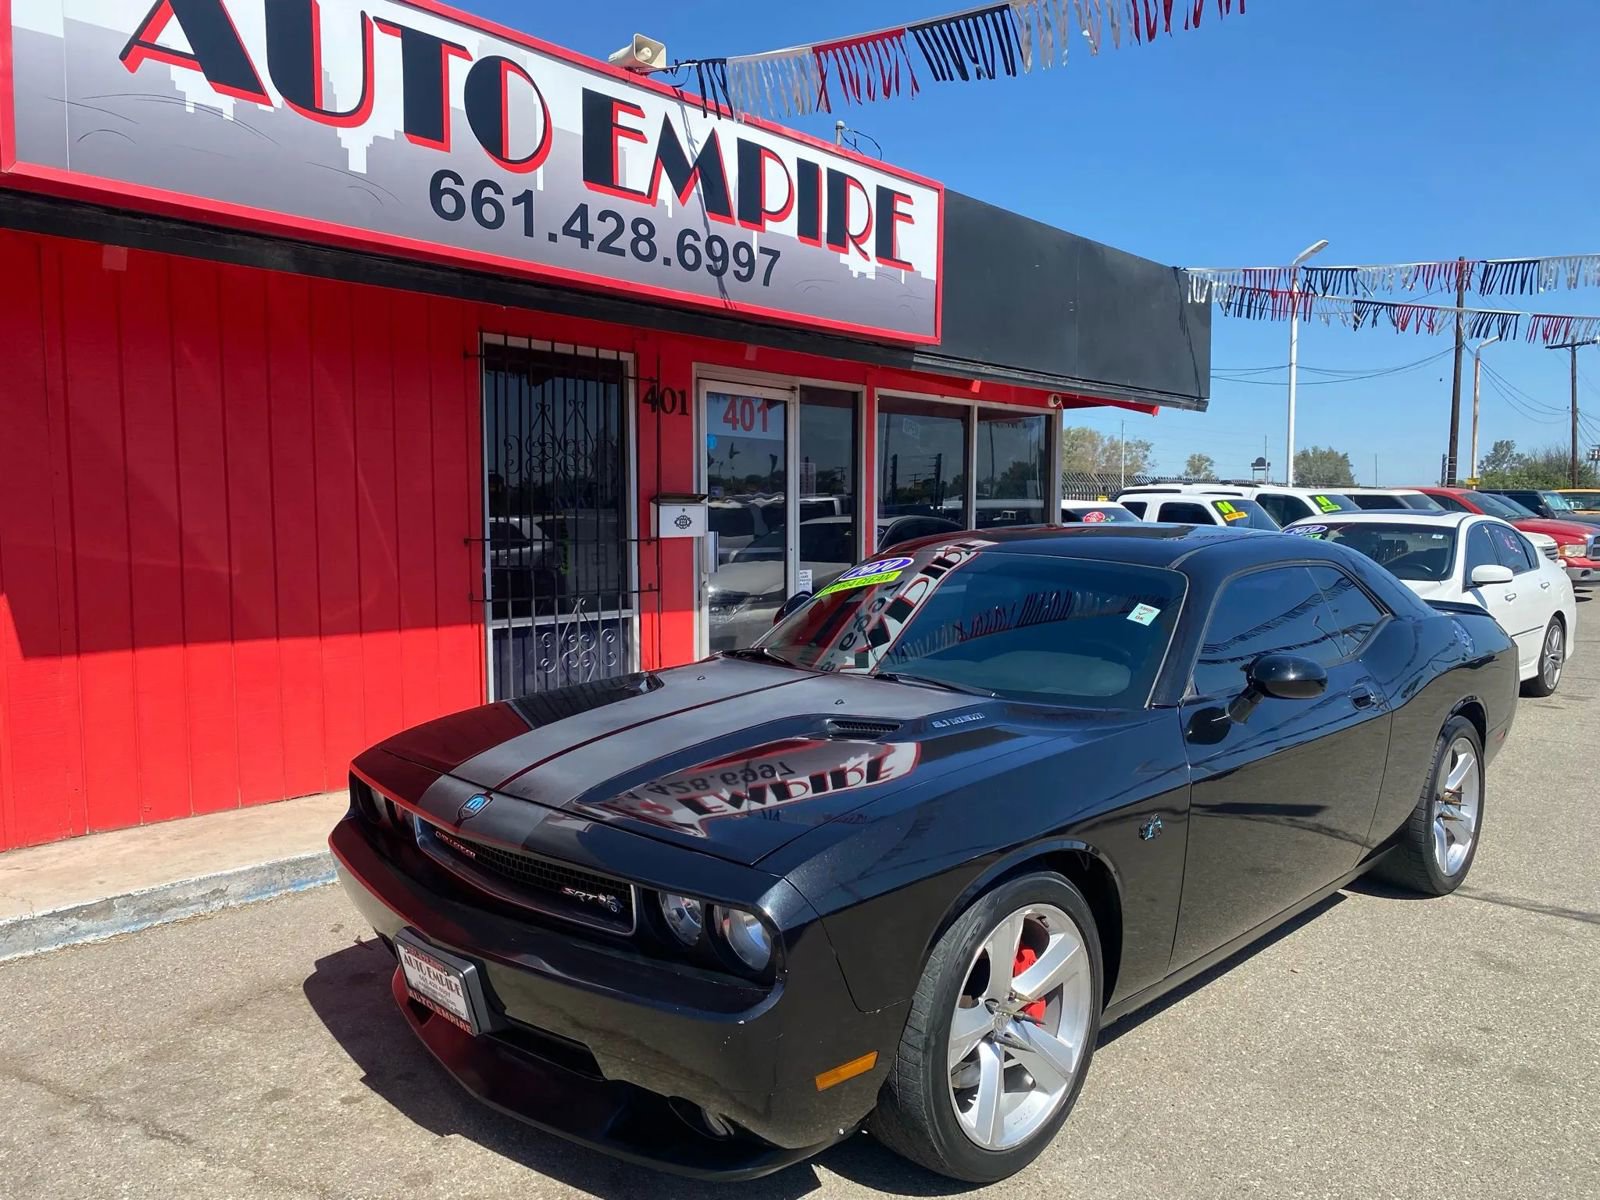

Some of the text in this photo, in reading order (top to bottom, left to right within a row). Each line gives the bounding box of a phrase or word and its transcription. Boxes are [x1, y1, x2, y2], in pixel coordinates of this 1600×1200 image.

[118, 0, 915, 272] AUTO EMPIRE
[429, 168, 782, 287] 661.428.6997
[642, 384, 689, 416] 401
[723, 397, 769, 433] 401
